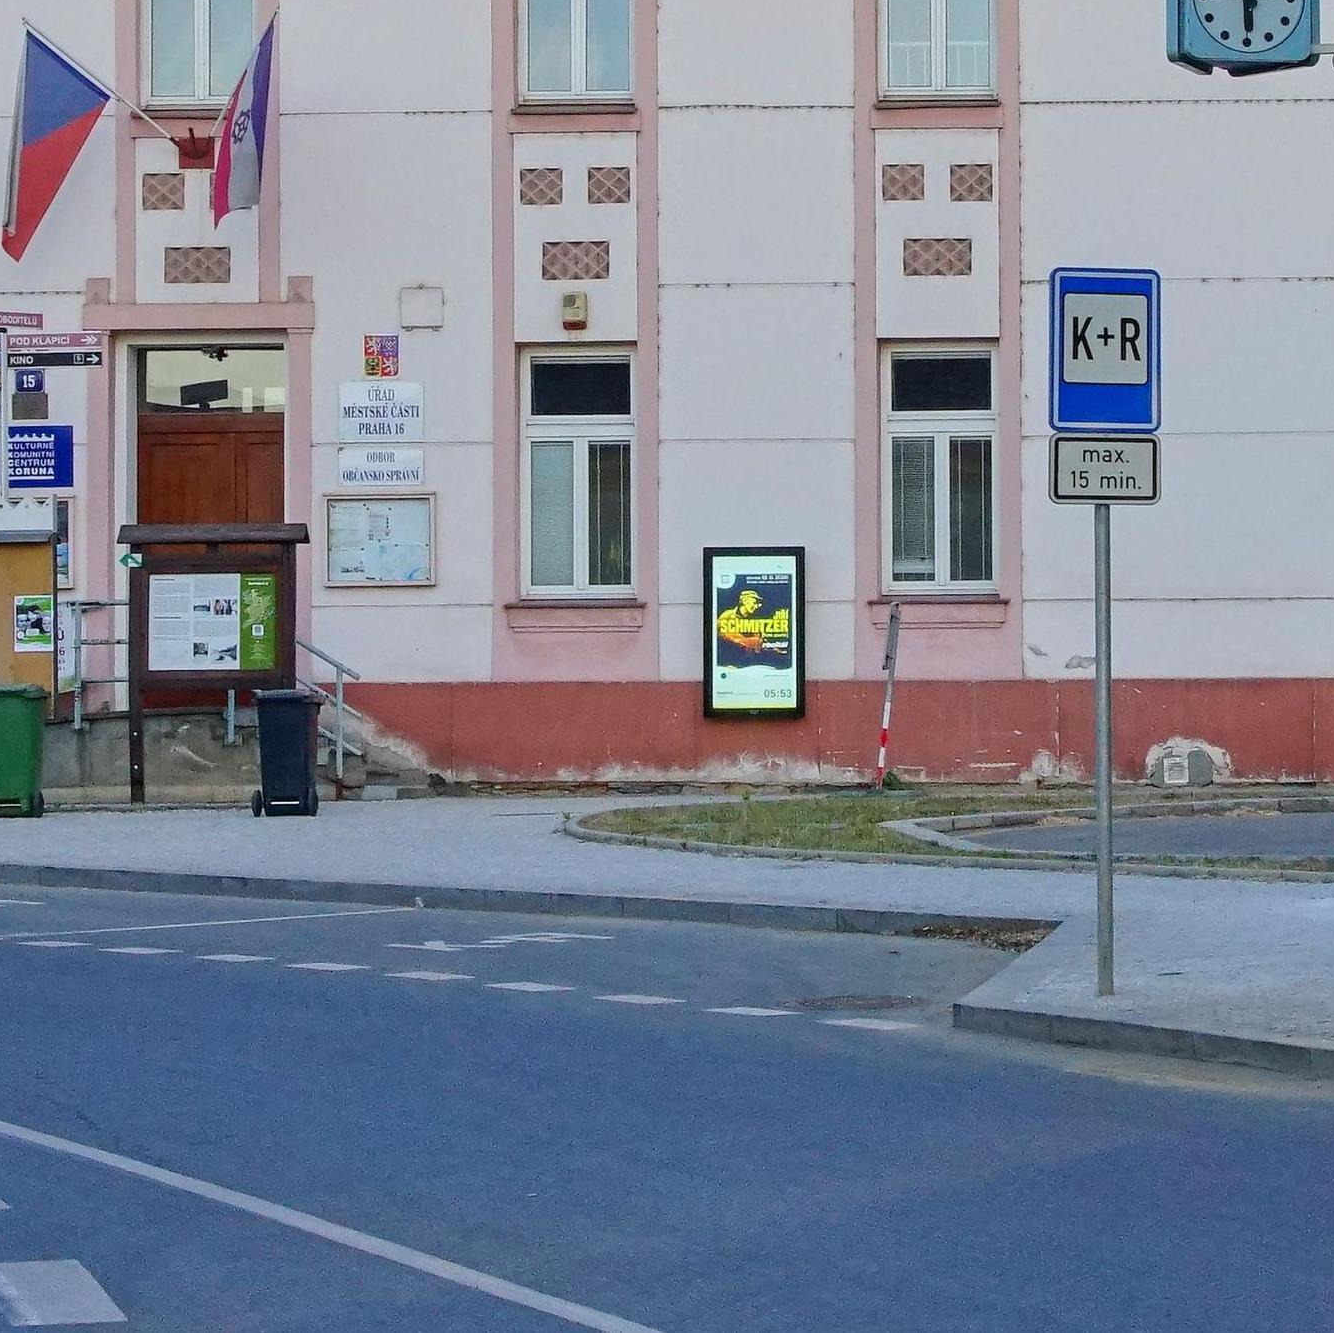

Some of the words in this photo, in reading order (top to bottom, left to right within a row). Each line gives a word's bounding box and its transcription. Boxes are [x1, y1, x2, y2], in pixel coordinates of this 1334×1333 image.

[9, 337, 30, 346] POD
[1071, 316, 1141, 361] K+R
[9, 355, 34, 365] KINO
[22, 374, 36, 388] 15
[367, 385, 395, 402] ÚŘAD
[342, 403, 389, 419] MĚSTSKÉ
[390, 402, 420, 418] ČÁSTI
[358, 422, 392, 435] PRAHA
[394, 422, 405, 435] 16
[366, 451, 396, 463] ODBOR
[1082, 448, 1130, 464] max.
[8, 459, 55, 467] CENTRUM
[8, 467, 55, 475] KORUNA
[1070, 470, 1090, 490] 15
[1099, 470, 1142, 490] min.
[720, 618, 789, 633] SCHMITZER
[763, 689, 792, 698] 05:53
